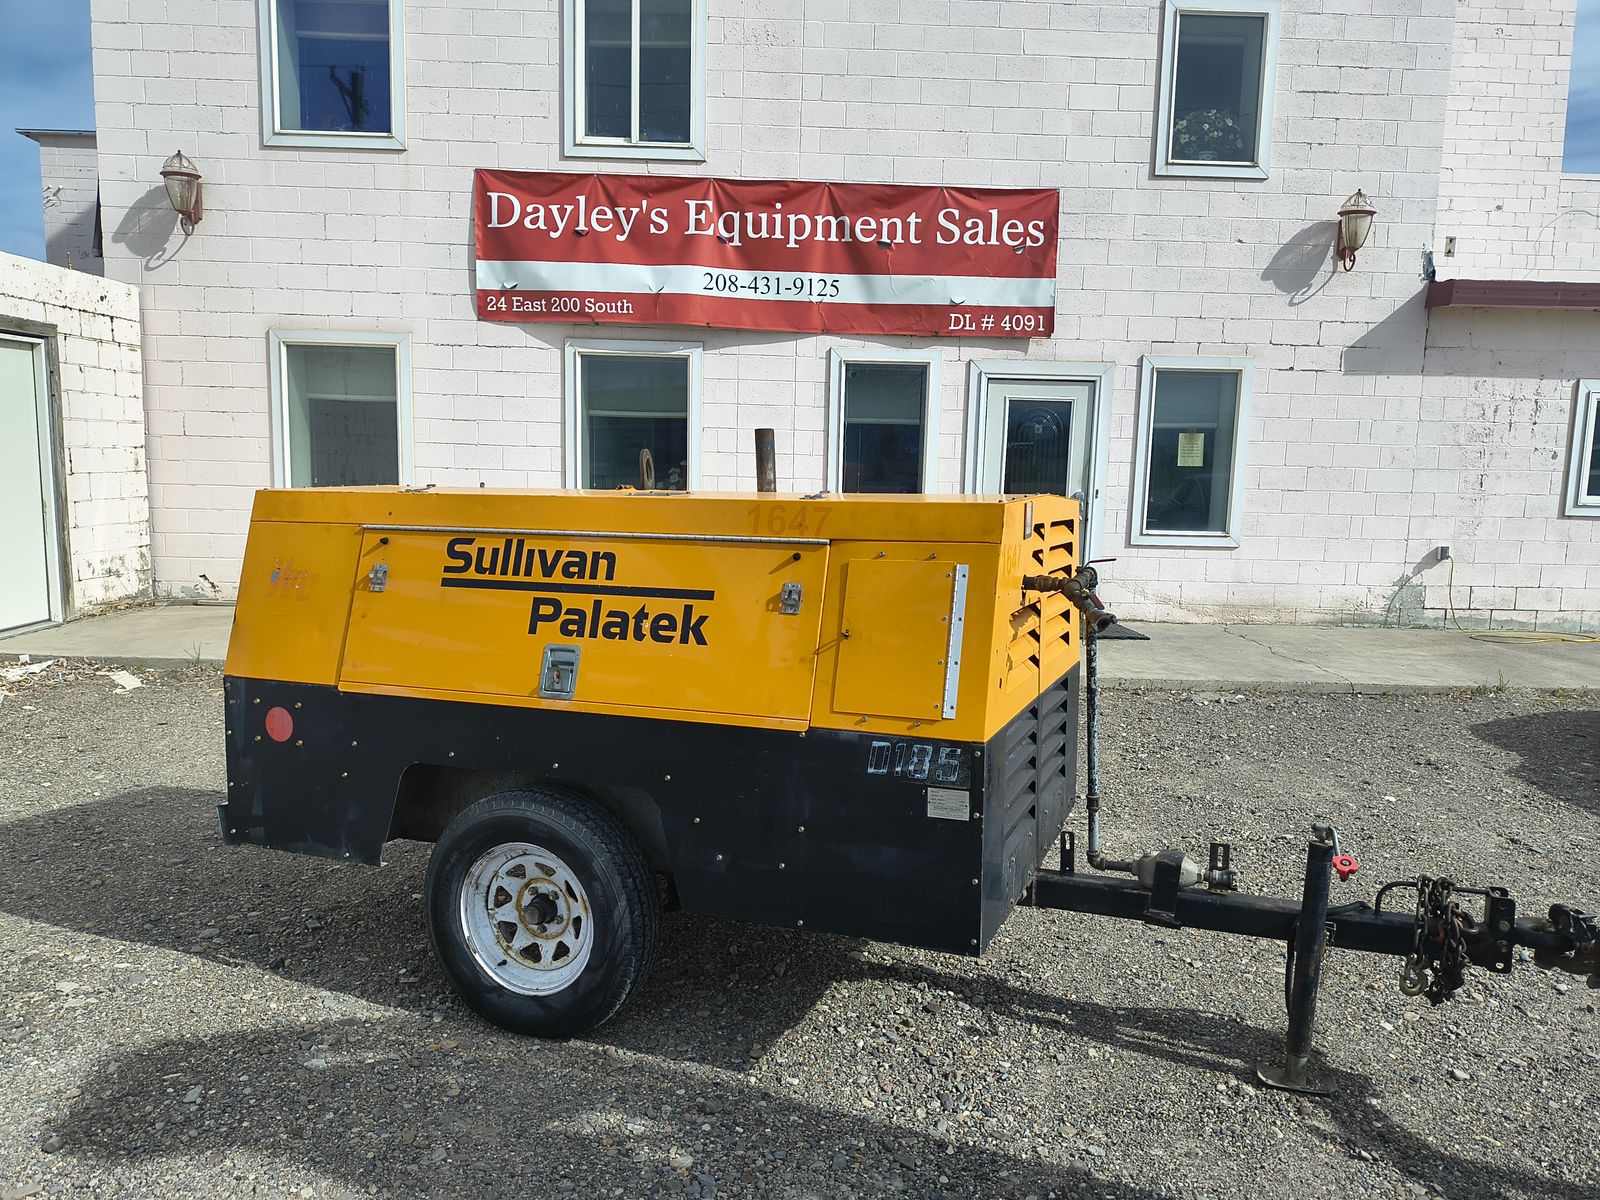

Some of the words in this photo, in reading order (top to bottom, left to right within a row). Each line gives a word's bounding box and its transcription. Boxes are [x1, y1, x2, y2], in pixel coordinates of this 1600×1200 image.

[486, 191, 668, 242] Dayley's
[684, 199, 922, 248] Equipment
[936, 208, 1046, 248] Sales
[702, 272, 840, 298] 208-431-9125
[486, 296, 508, 313] 24
[511, 296, 547, 314] East
[550, 297, 580, 314] 200
[584, 298, 635, 315] South
[949, 313, 975, 330] DL
[980, 314, 996, 331] #
[1000, 315, 1047, 332] 4091
[747, 503, 832, 536] 1647
[442, 537, 617, 581] Sullivan
[527, 596, 710, 646] Palatek
[867, 741, 961, 782] D185
